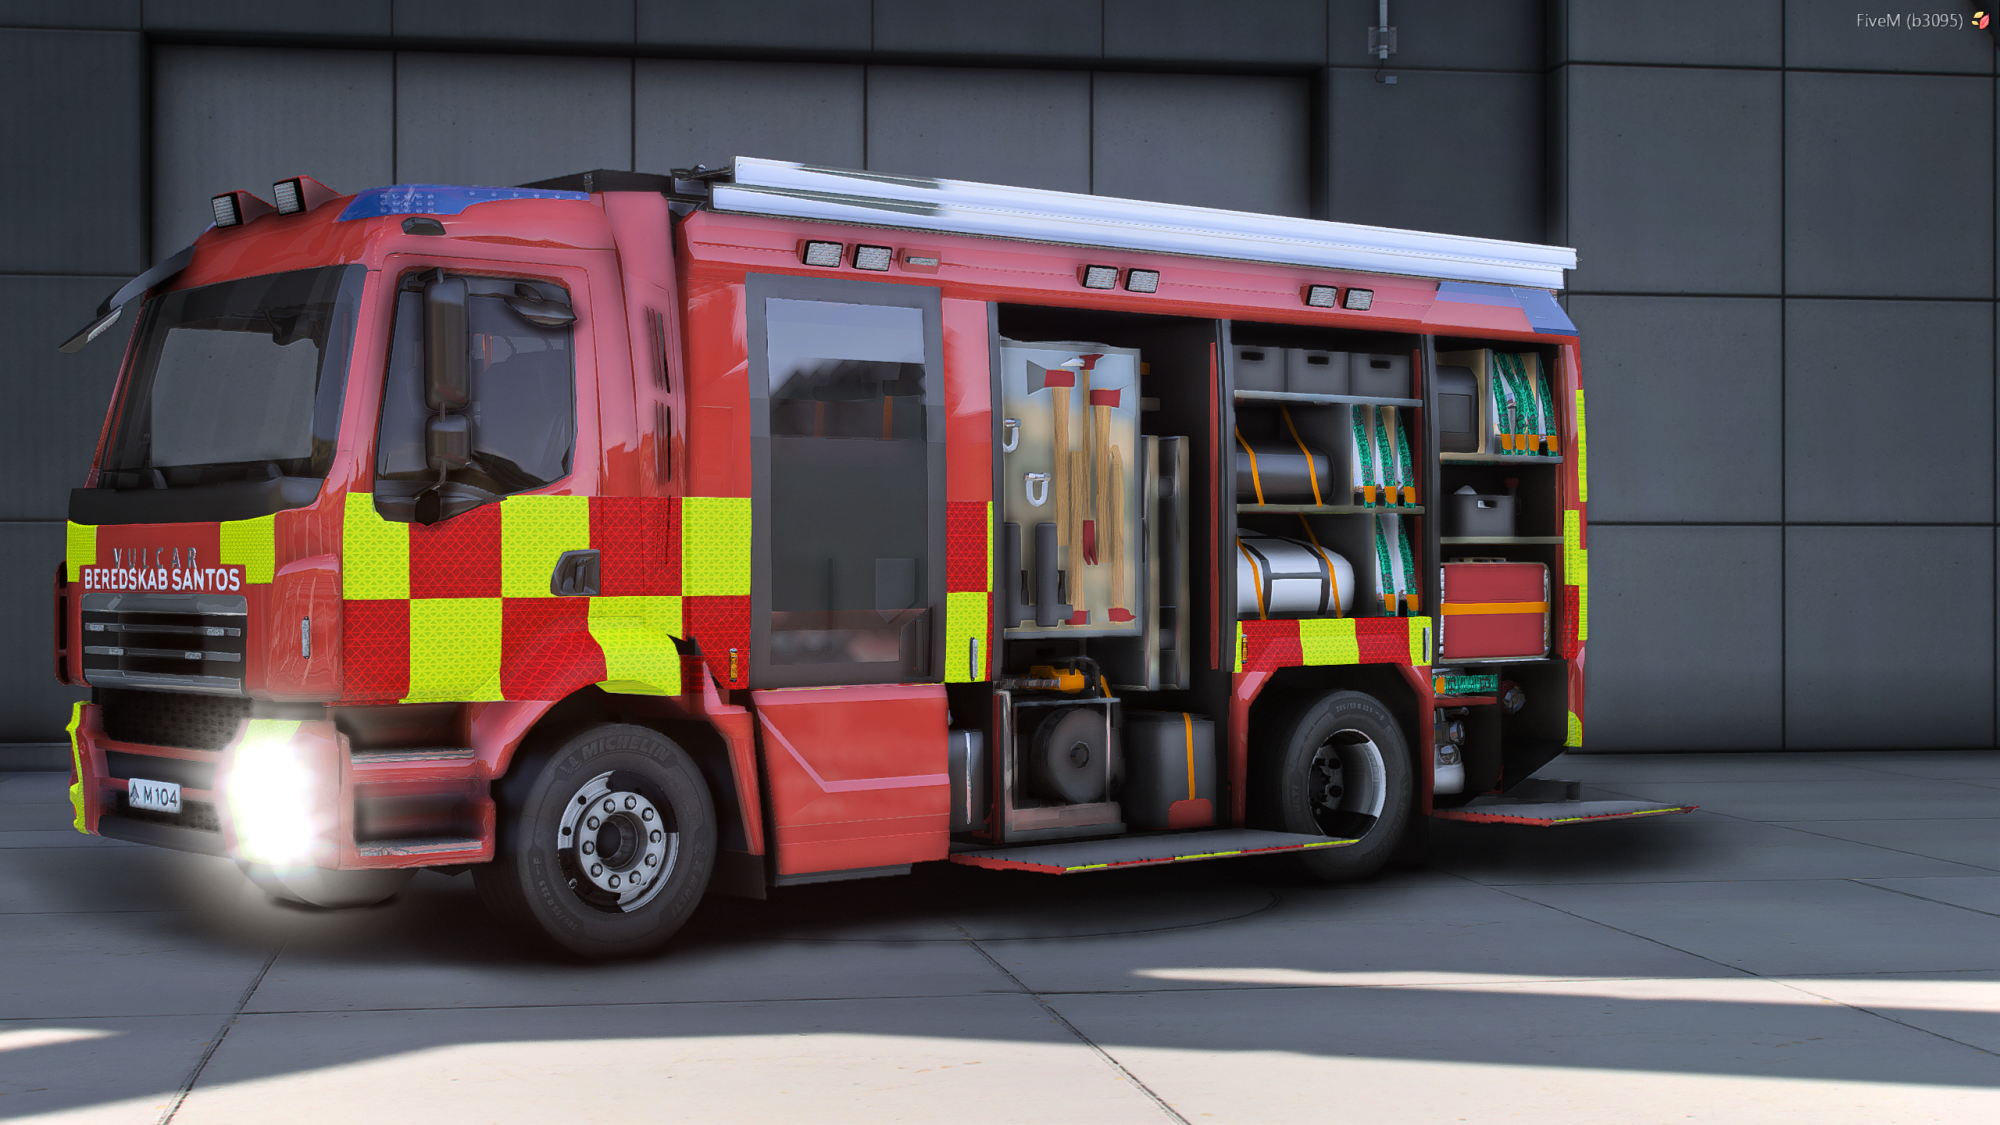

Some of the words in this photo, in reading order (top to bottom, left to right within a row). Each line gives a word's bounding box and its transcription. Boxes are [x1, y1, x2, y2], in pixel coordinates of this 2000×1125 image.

[113, 547, 197, 569] VULCAR
[84, 568, 168, 591] BEREDSKAB
[172, 568, 241, 592] SANTOS
[582, 735, 673, 762] MICHELIN
